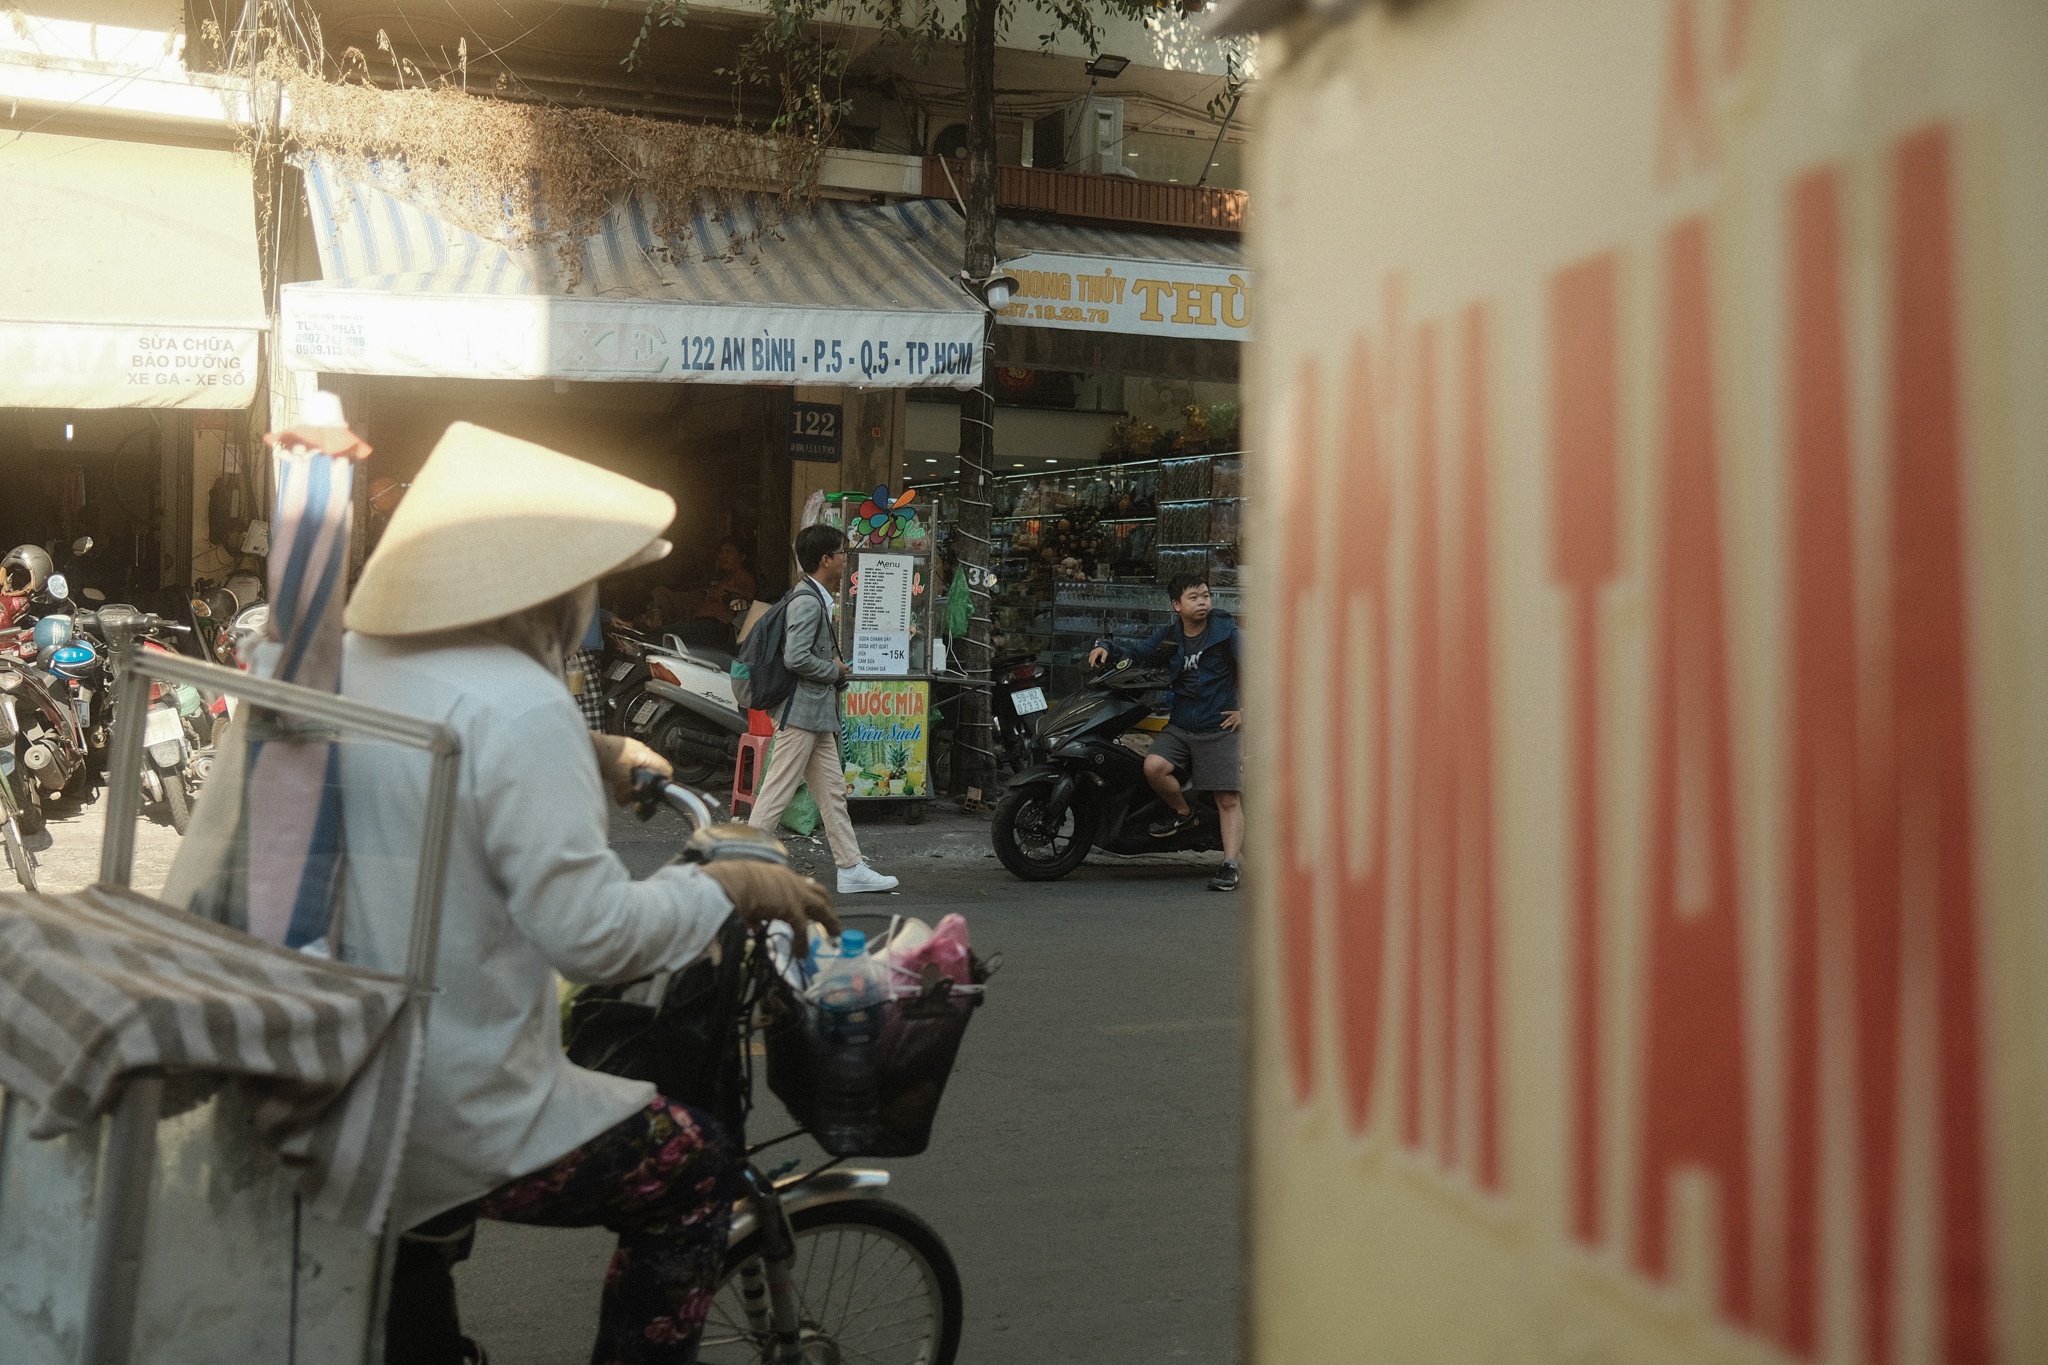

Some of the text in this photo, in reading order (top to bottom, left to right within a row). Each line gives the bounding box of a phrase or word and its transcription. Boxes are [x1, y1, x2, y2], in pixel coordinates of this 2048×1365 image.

[1077, 267, 1127, 305] THỦY
[139, 333, 235, 352] SỬA CHỮA
[175, 353, 241, 369] DƯỠNG
[681, 335, 715, 371] 122
[720, 336, 746, 372] AN
[752, 329, 796, 373] BÌNH
[814, 338, 843, 374] P.5
[860, 340, 889, 380] Q.5
[906, 341, 973, 375] TP.HCM
[127, 372, 150, 385] XE
[155, 372, 181, 386] GA
[195, 373, 217, 386] XE
[222, 369, 246, 386] SỐ
[792, 410, 835, 437] 122
[876, 559, 901, 570] Menu
[890, 650, 904, 659] 15K
[846, 686, 925, 716] NƯỚC MÍA
[851, 721, 922, 744] Siêu Sạch
